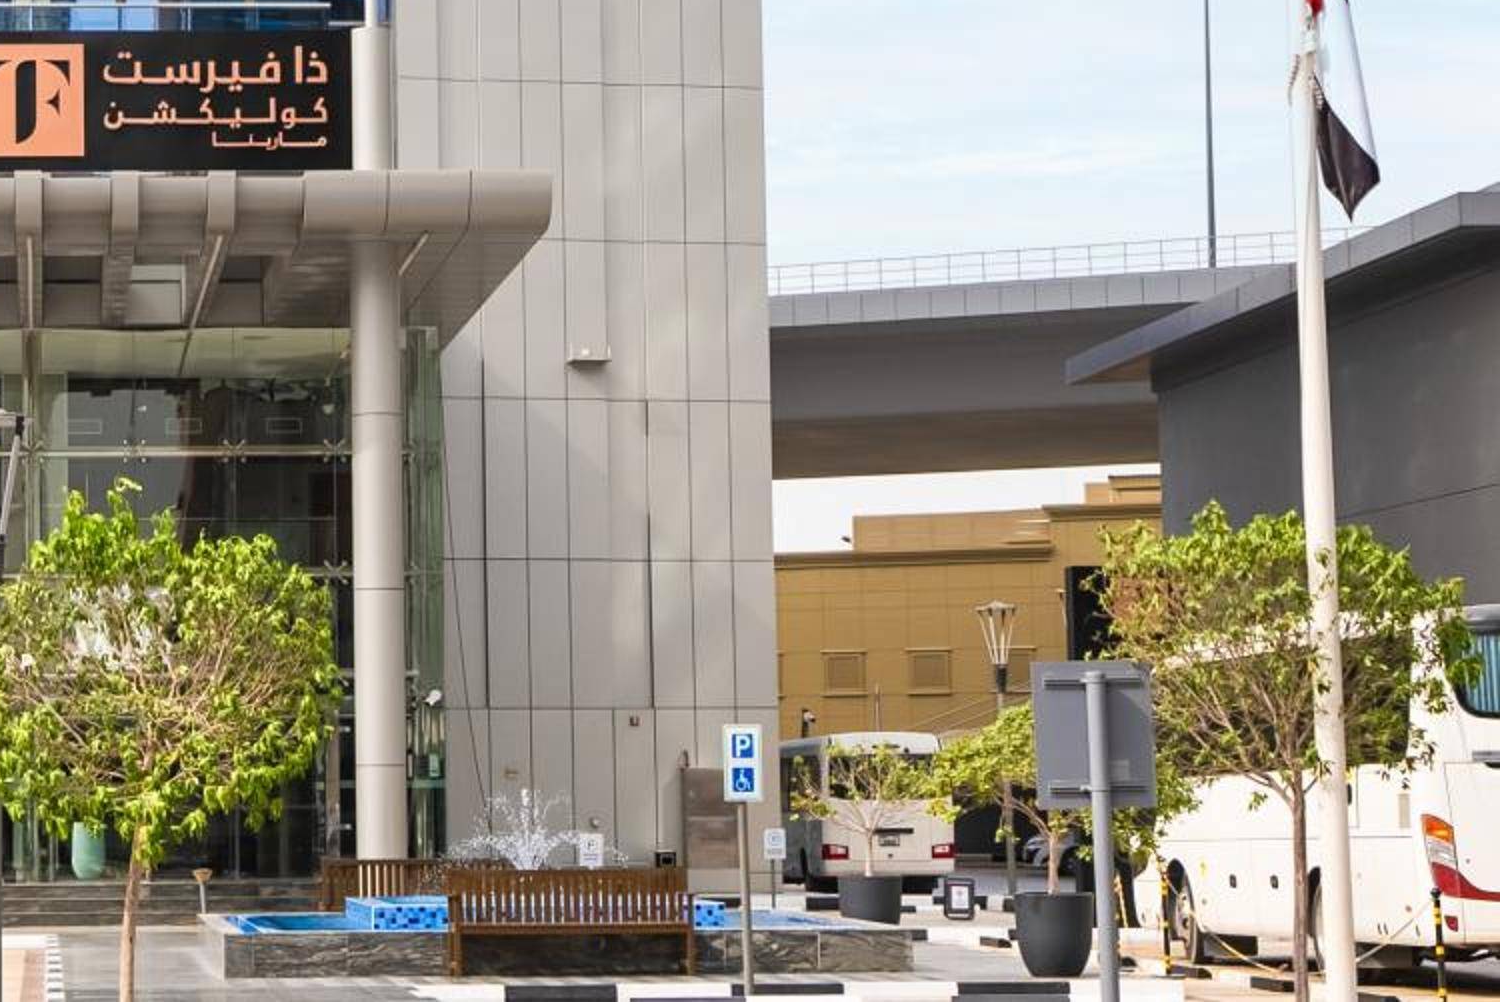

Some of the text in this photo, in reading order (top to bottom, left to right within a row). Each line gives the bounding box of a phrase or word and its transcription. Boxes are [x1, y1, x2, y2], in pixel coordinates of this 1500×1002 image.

[103, 45, 328, 93] ذا فيرست
[735, 735, 751, 758] P
